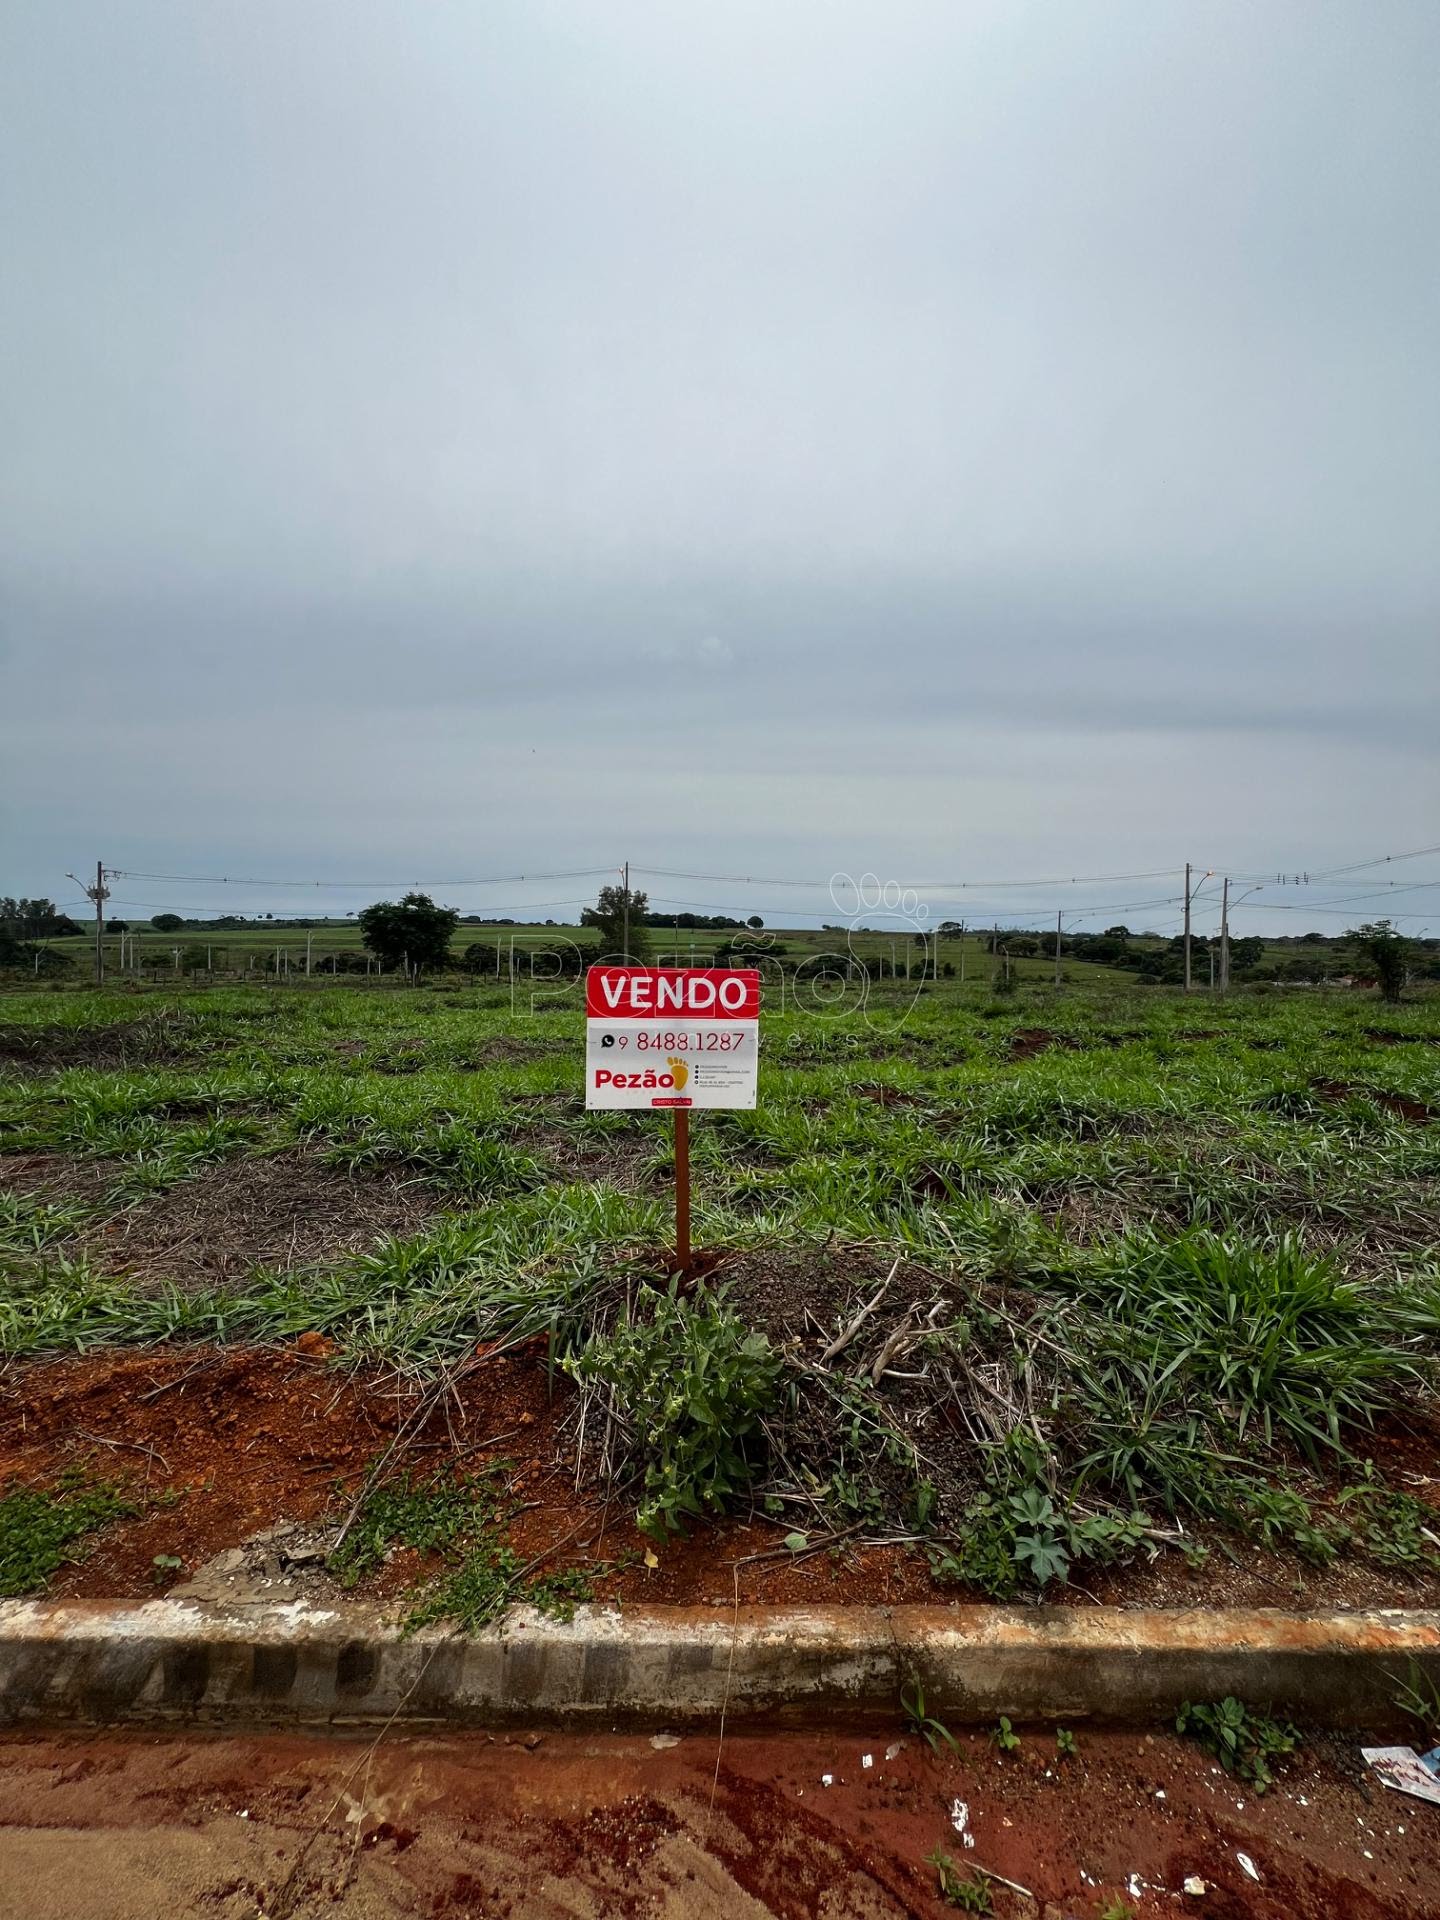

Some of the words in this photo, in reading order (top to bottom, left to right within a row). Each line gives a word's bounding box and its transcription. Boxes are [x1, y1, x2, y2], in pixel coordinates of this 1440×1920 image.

[600, 975, 747, 1010] VENDO
[618, 1036, 629, 1049] 9
[637, 1032, 745, 1051] 8488.1287
[595, 1069, 675, 1089] Pezão
